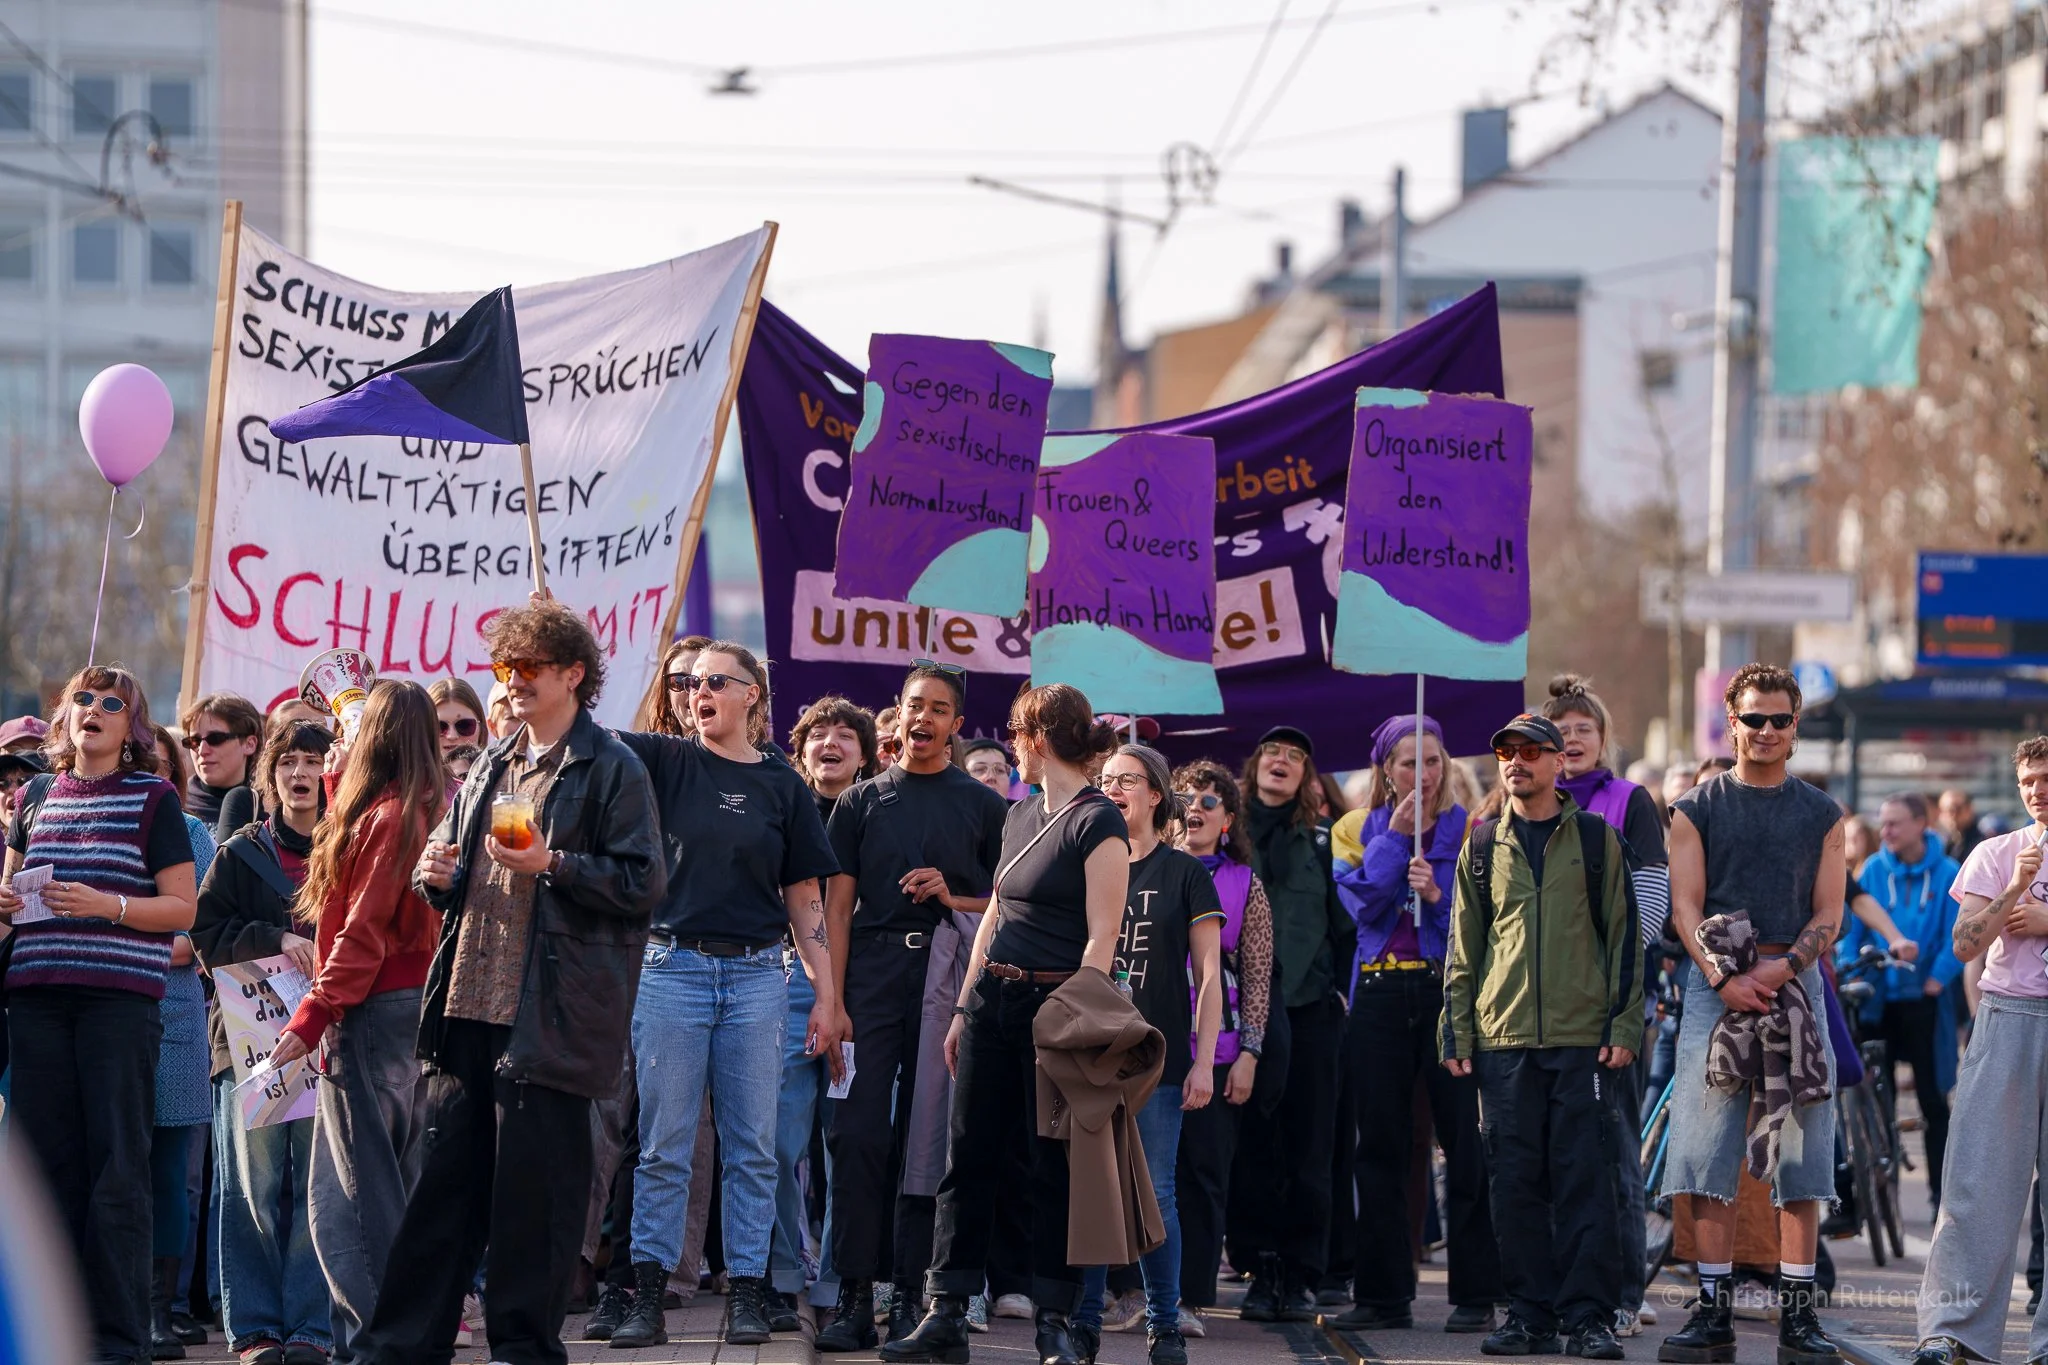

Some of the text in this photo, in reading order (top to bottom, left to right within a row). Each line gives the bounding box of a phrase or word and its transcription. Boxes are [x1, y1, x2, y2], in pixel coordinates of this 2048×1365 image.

[243, 261, 409, 342] SCHLUSS
[239, 313, 385, 391] SEXiST
[522, 325, 720, 406] SPRÜCHEN
[892, 361, 1032, 417] Gegen den
[896, 416, 1035, 473] sexistischen
[1365, 418, 1507, 473] Organisiert
[869, 474, 1025, 530] Normalzustand
[1039, 471, 1152, 516] Frauen &
[1216, 455, 1316, 502] rbeit
[1398, 475, 1442, 510] den
[1104, 519, 1199, 561] Queers
[1363, 528, 1514, 574] Widerstand!
[811, 605, 978, 655] unite
[1036, 588, 1111, 629] Hand
[1118, 603, 1144, 629] in
[1150, 586, 1213, 634] Hand
[264, 1069, 289, 1100] ist
